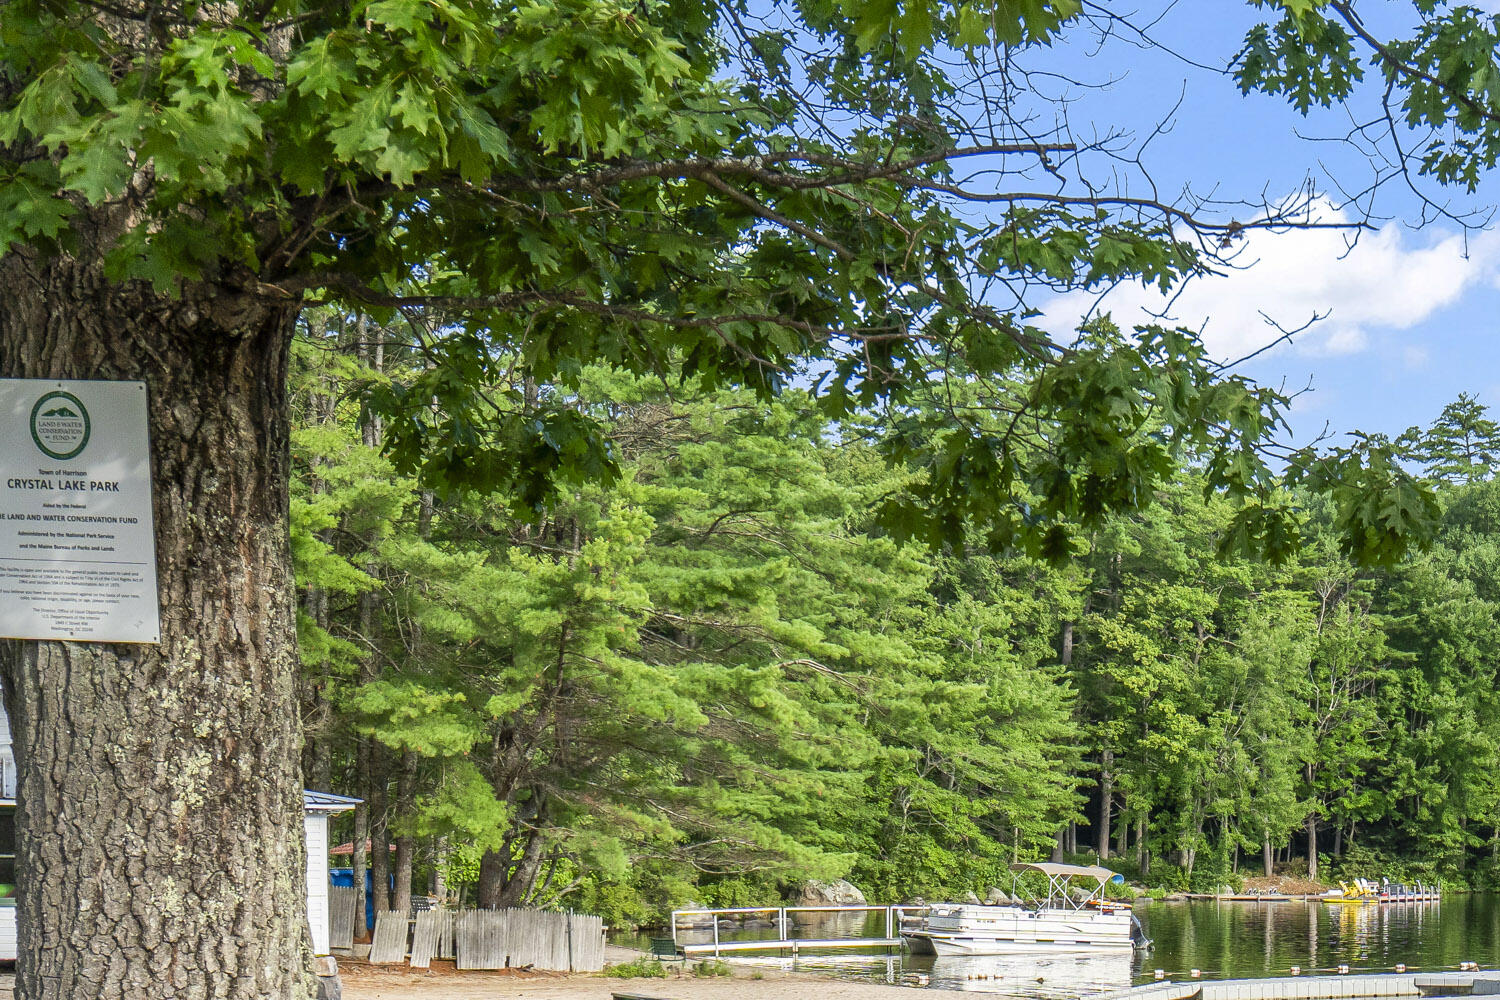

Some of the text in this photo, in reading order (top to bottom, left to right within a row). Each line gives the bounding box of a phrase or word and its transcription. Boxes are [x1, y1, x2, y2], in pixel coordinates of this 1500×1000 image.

[7, 478, 120, 492] CRYSTAL LAKE PARK
[67, 515, 117, 523] CONSERVATION
